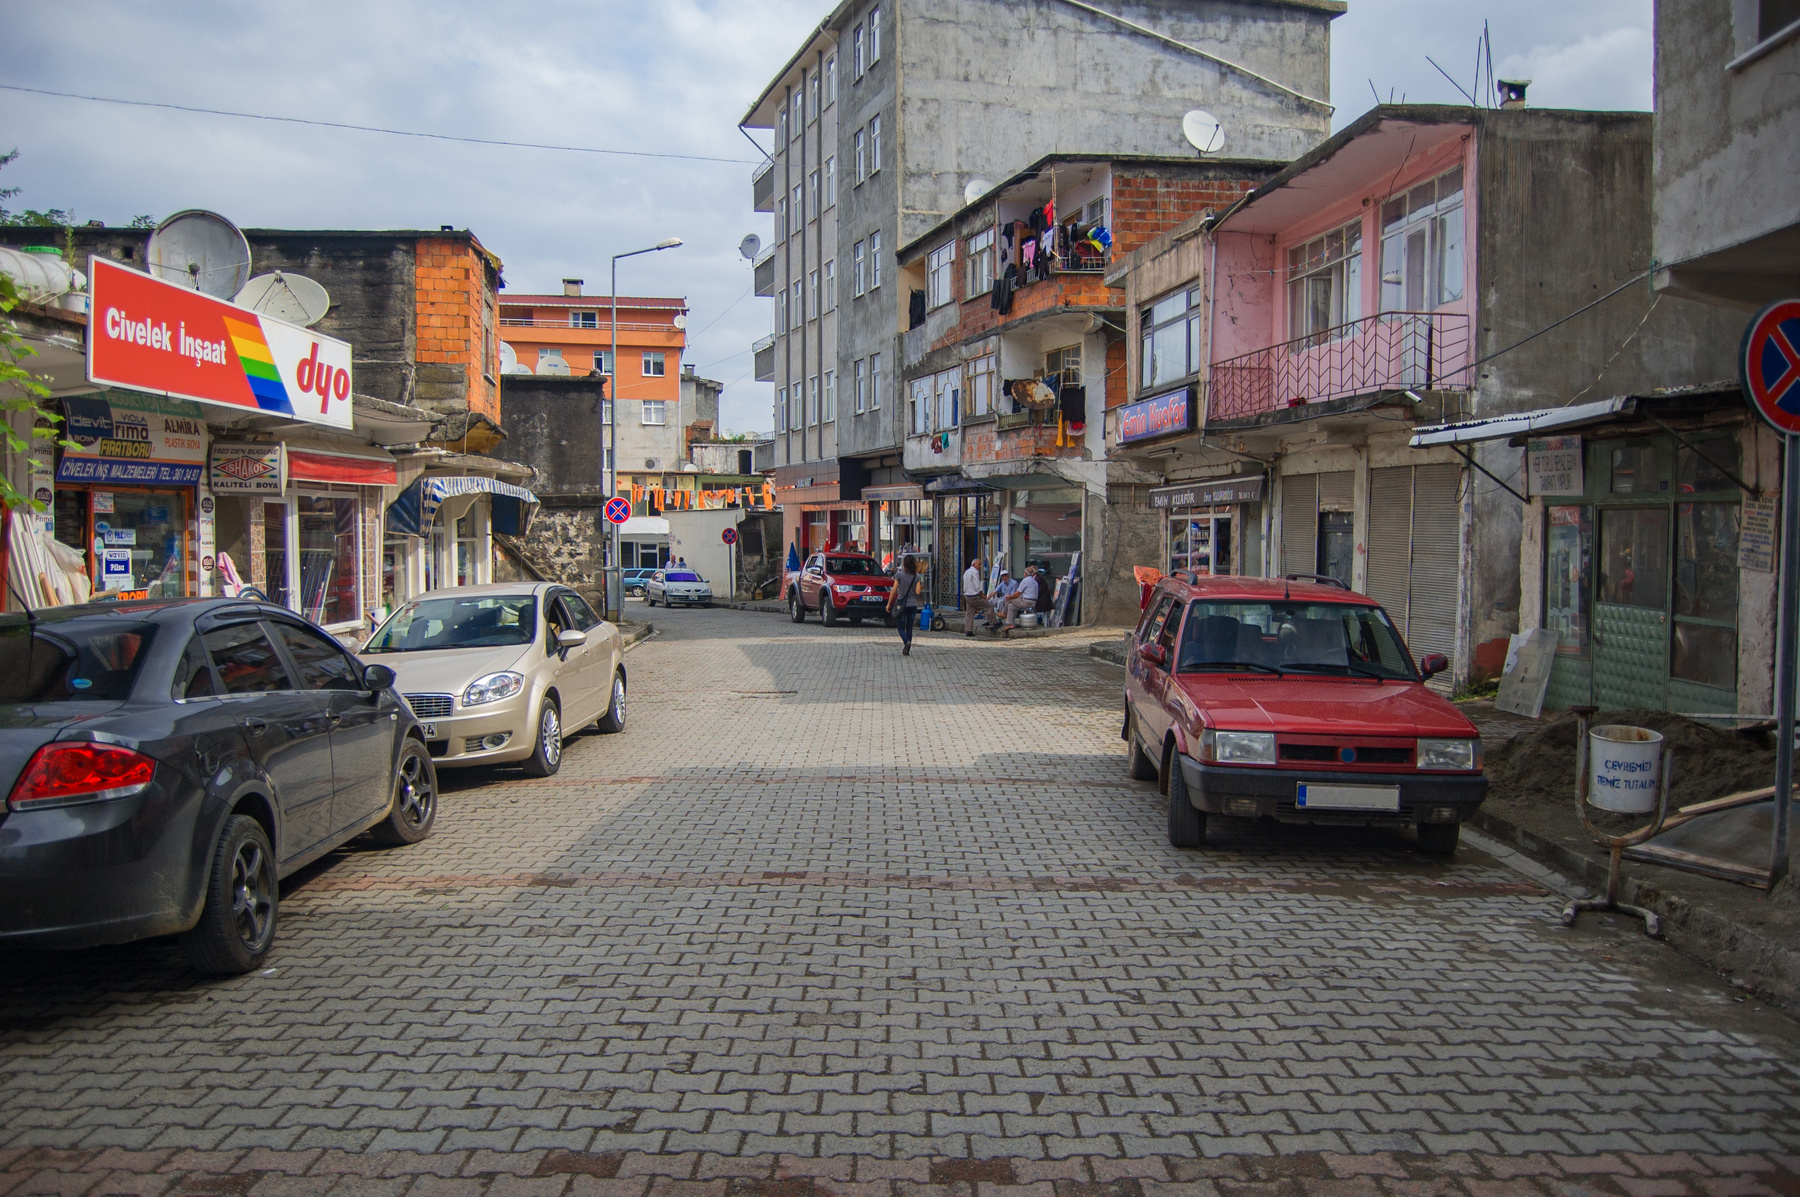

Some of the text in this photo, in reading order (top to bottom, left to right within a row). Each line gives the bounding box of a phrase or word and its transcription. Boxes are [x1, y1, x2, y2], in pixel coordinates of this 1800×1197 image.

[106, 307, 227, 367] Civelek İnşaat
[296, 341, 350, 415] dyo
[120, 413, 147, 423] VIOLA
[1123, 396, 1186, 437] Emin Kuaför
[115, 424, 149, 440] rima
[165, 418, 200, 436] ALMİRA
[75, 435, 96, 443] BOYA
[187, 439, 200, 450] BOYA
[100, 439, 150, 458] FIRATBORU
[62, 459, 95, 476] CİVELEK
[110, 464, 159, 479] MALZEMELERİ
[1154, 494, 1168, 507] EMİN
[1171, 490, 1195, 506] KUAFÖR
[1604, 759, 1652, 773] ÇEVREMİZİ
[1597, 775, 1656, 790] TEMİZ TUTALIM
